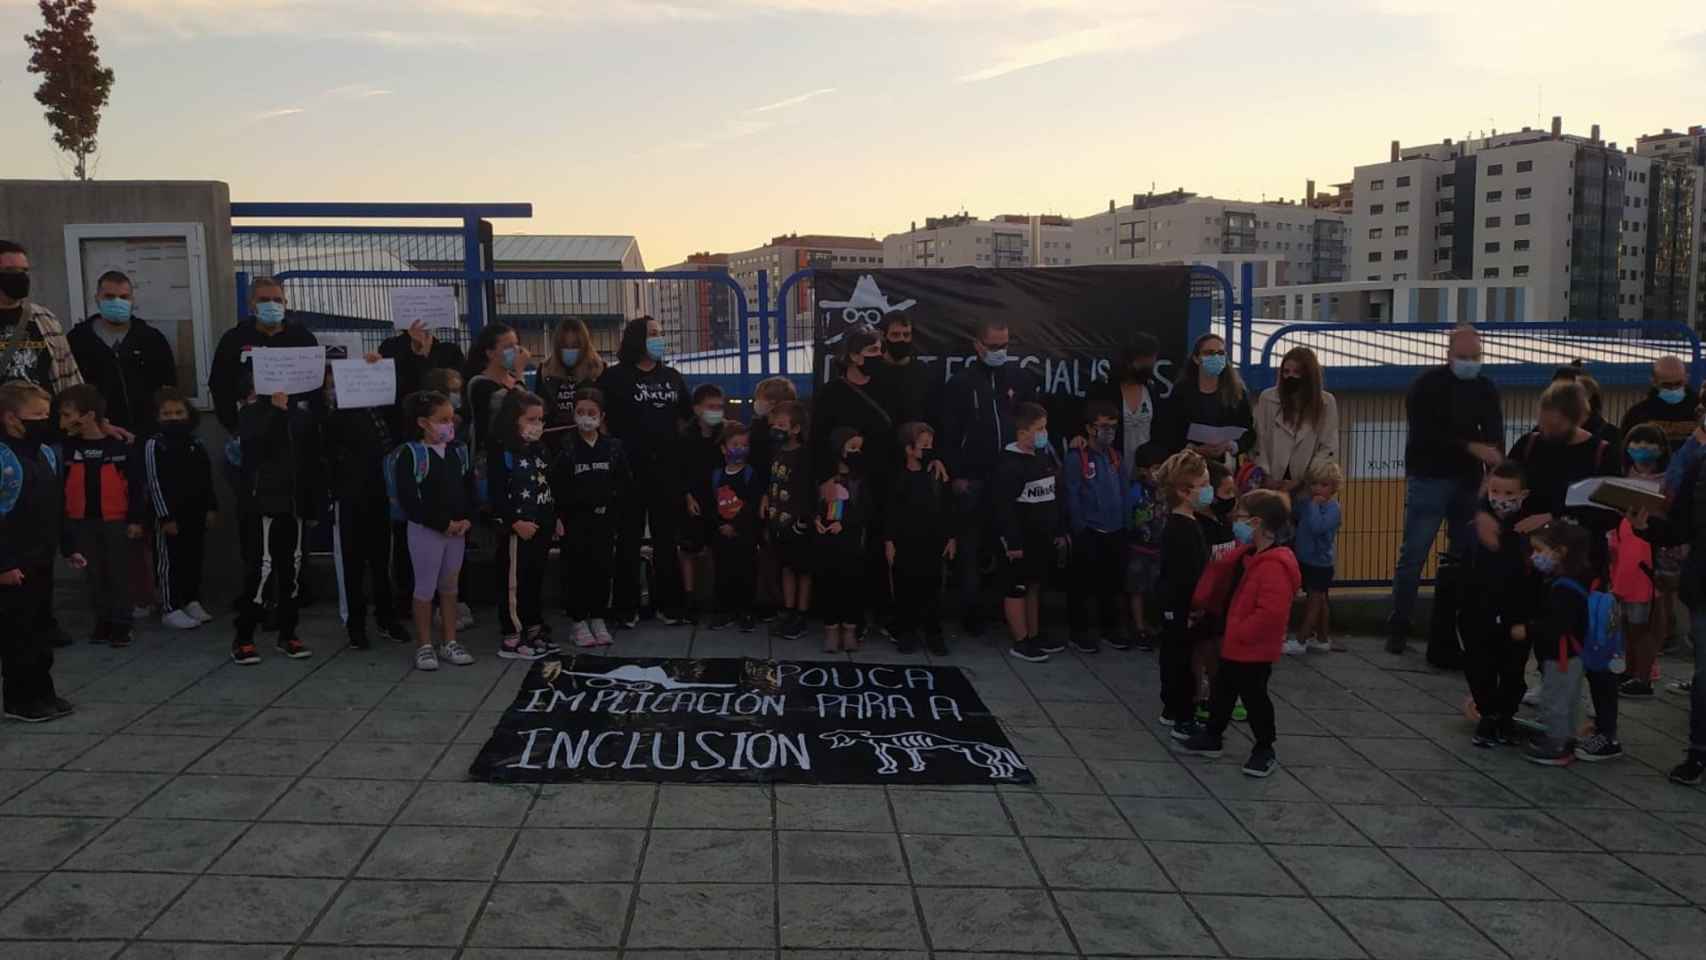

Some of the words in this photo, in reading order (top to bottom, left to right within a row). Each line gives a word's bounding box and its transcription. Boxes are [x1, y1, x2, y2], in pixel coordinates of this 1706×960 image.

[775, 664, 935, 691] POUCA
[516, 687, 787, 717] IMPLICACIÓN
[816, 691, 915, 719] PARA
[929, 695, 964, 722] A
[505, 727, 811, 770] INCLUSIÓN
